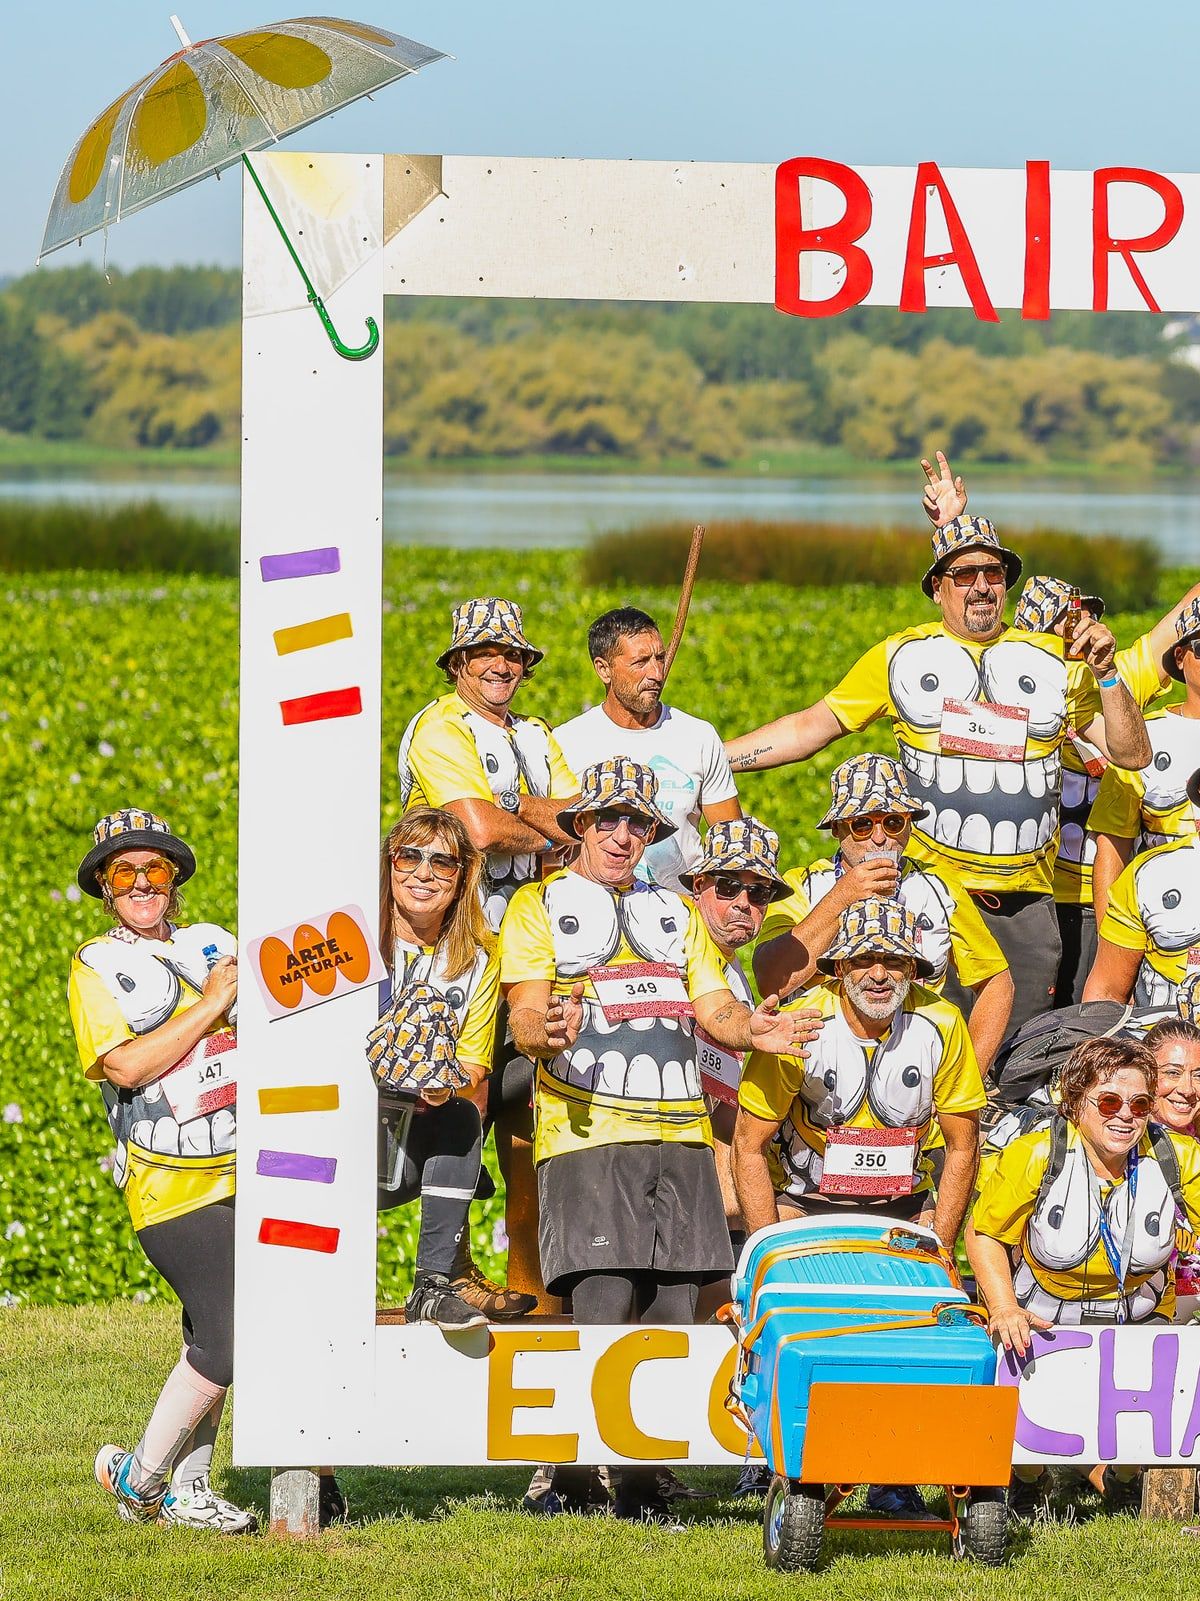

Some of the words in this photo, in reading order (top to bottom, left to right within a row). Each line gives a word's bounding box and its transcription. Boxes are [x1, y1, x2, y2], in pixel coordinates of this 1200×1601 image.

[286, 938, 340, 970] ARTE
[279, 951, 354, 986] NATURAL
[625, 982, 657, 995] 349
[701, 1049, 722, 1071] 358
[854, 1153, 886, 1167] 350
